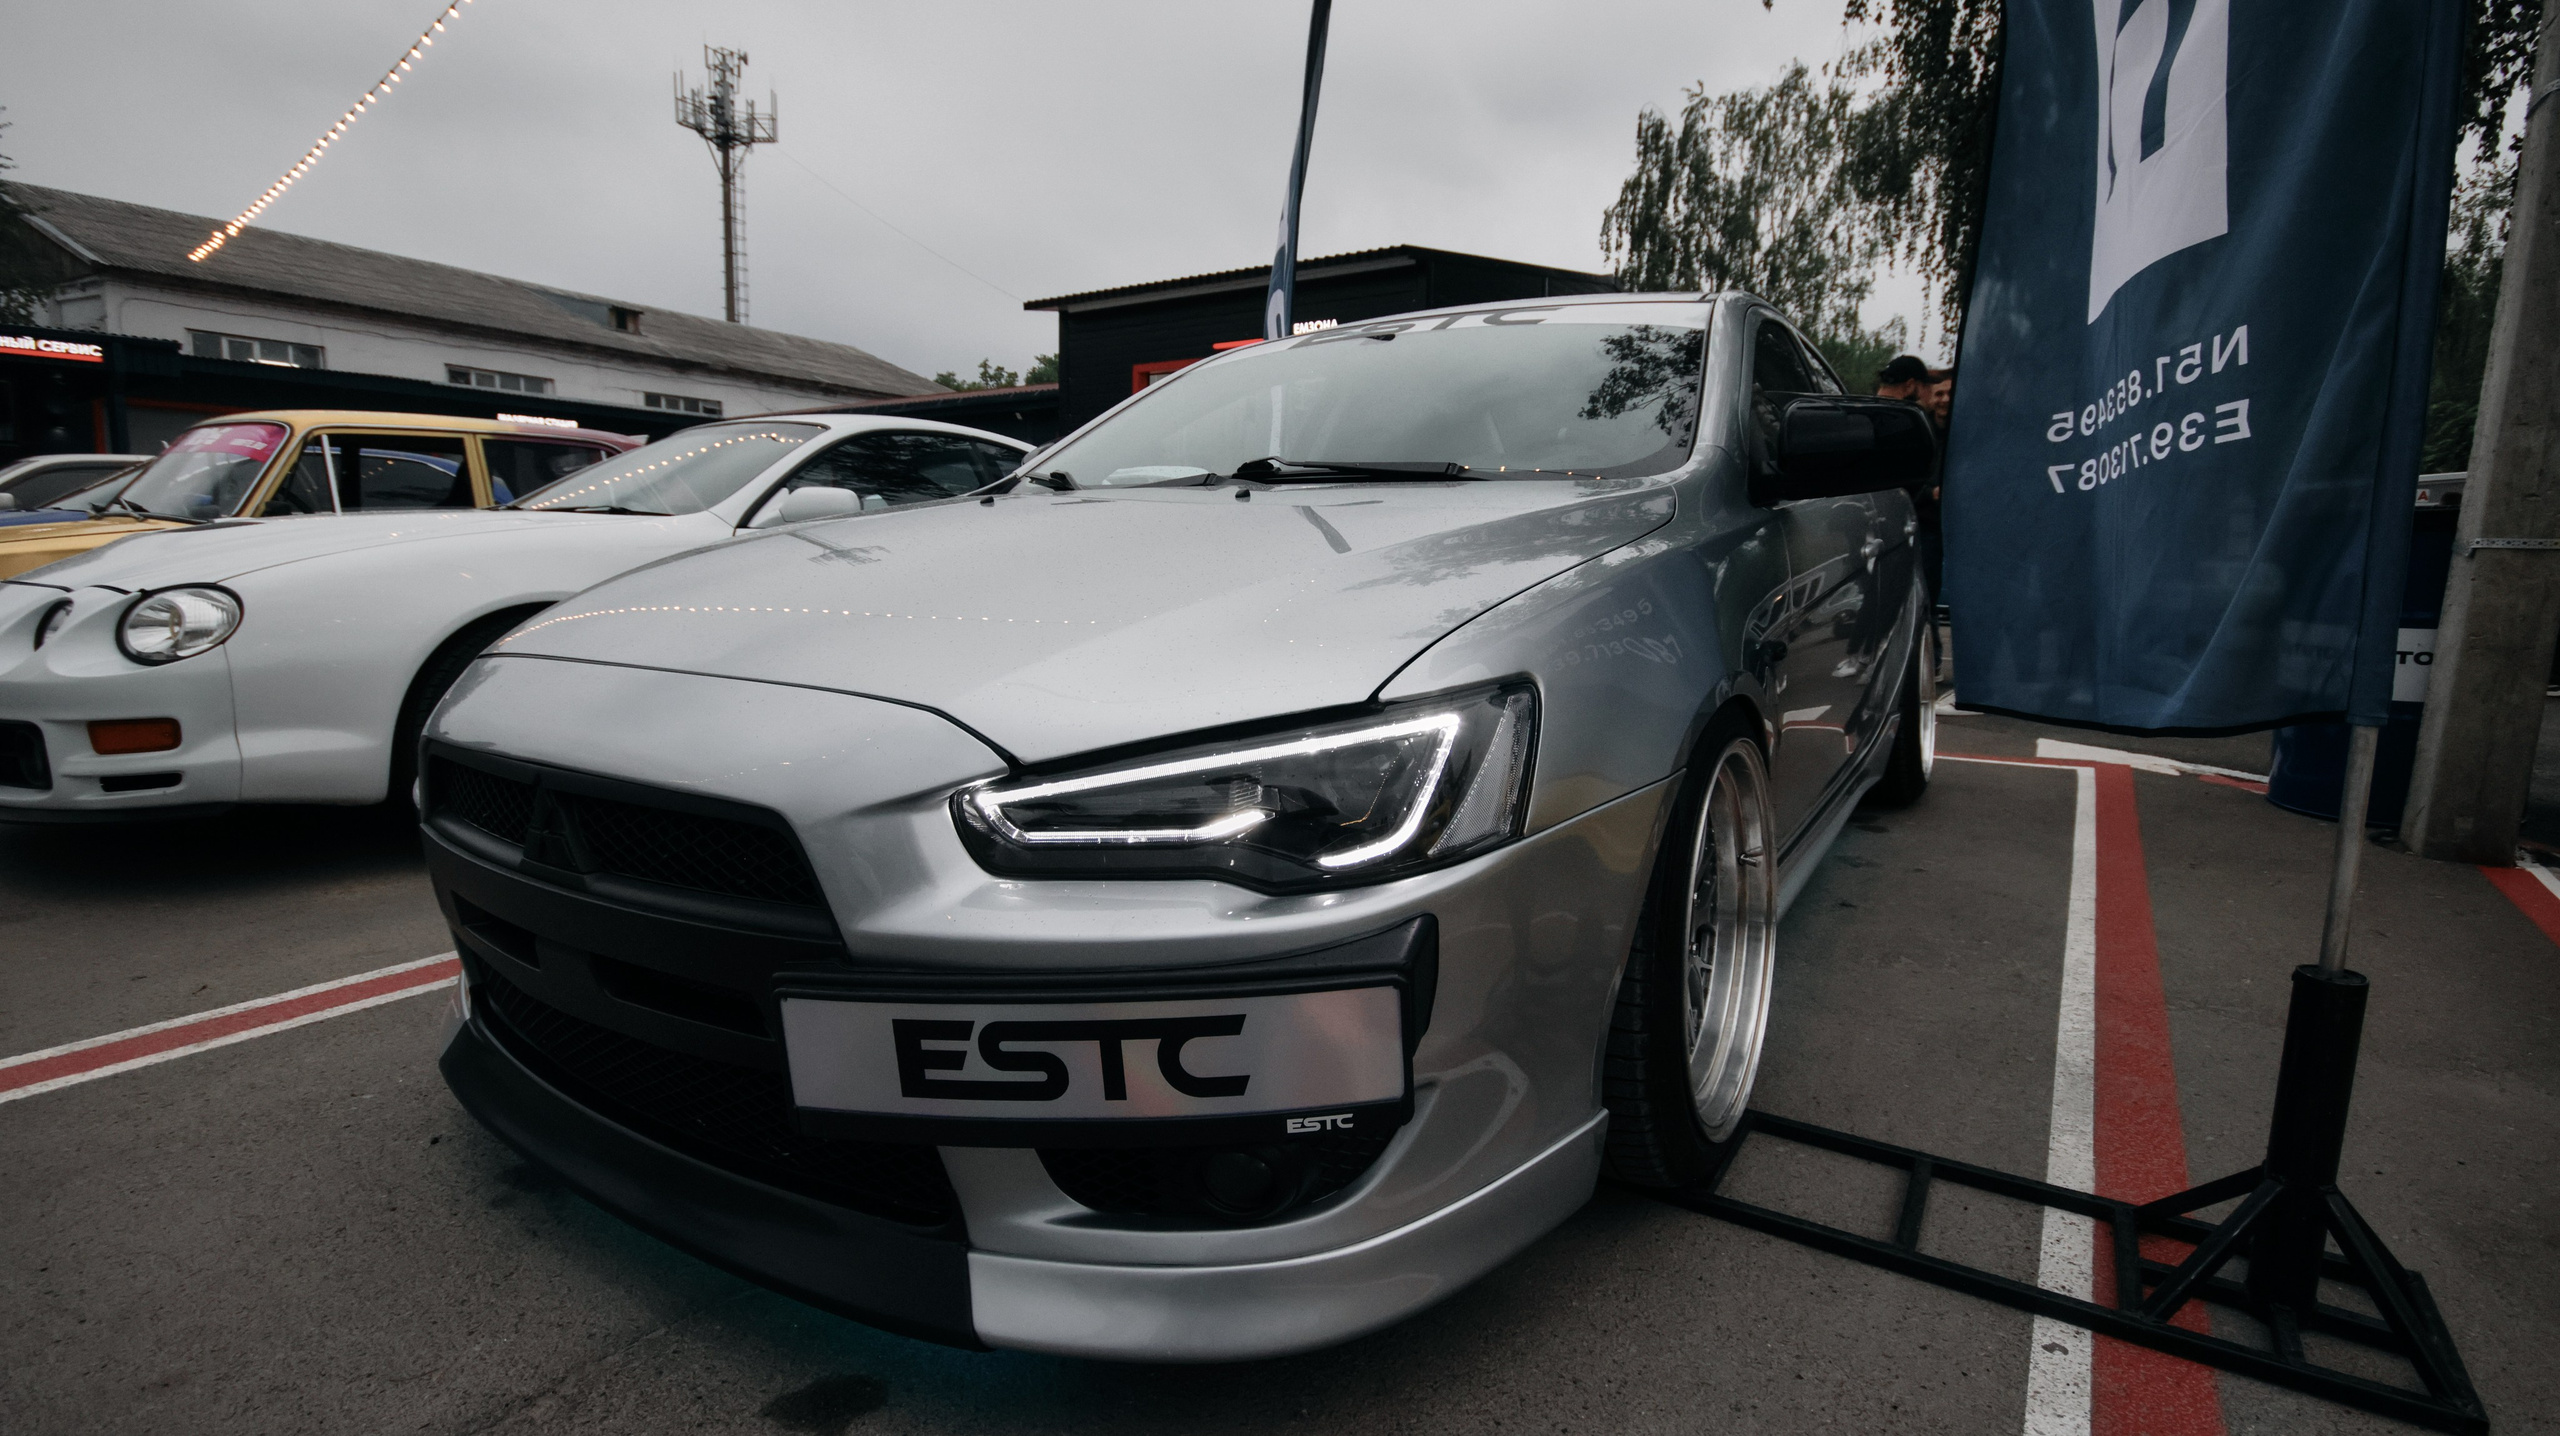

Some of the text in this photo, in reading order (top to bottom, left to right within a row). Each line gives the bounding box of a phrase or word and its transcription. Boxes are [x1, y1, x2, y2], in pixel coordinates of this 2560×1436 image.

[1286, 307, 1562, 350] ESTC
[37, 339, 103, 357] СЕРВИС
[892, 1013, 1251, 1101] ESTC
[1286, 1113, 1354, 1134] ESTC
